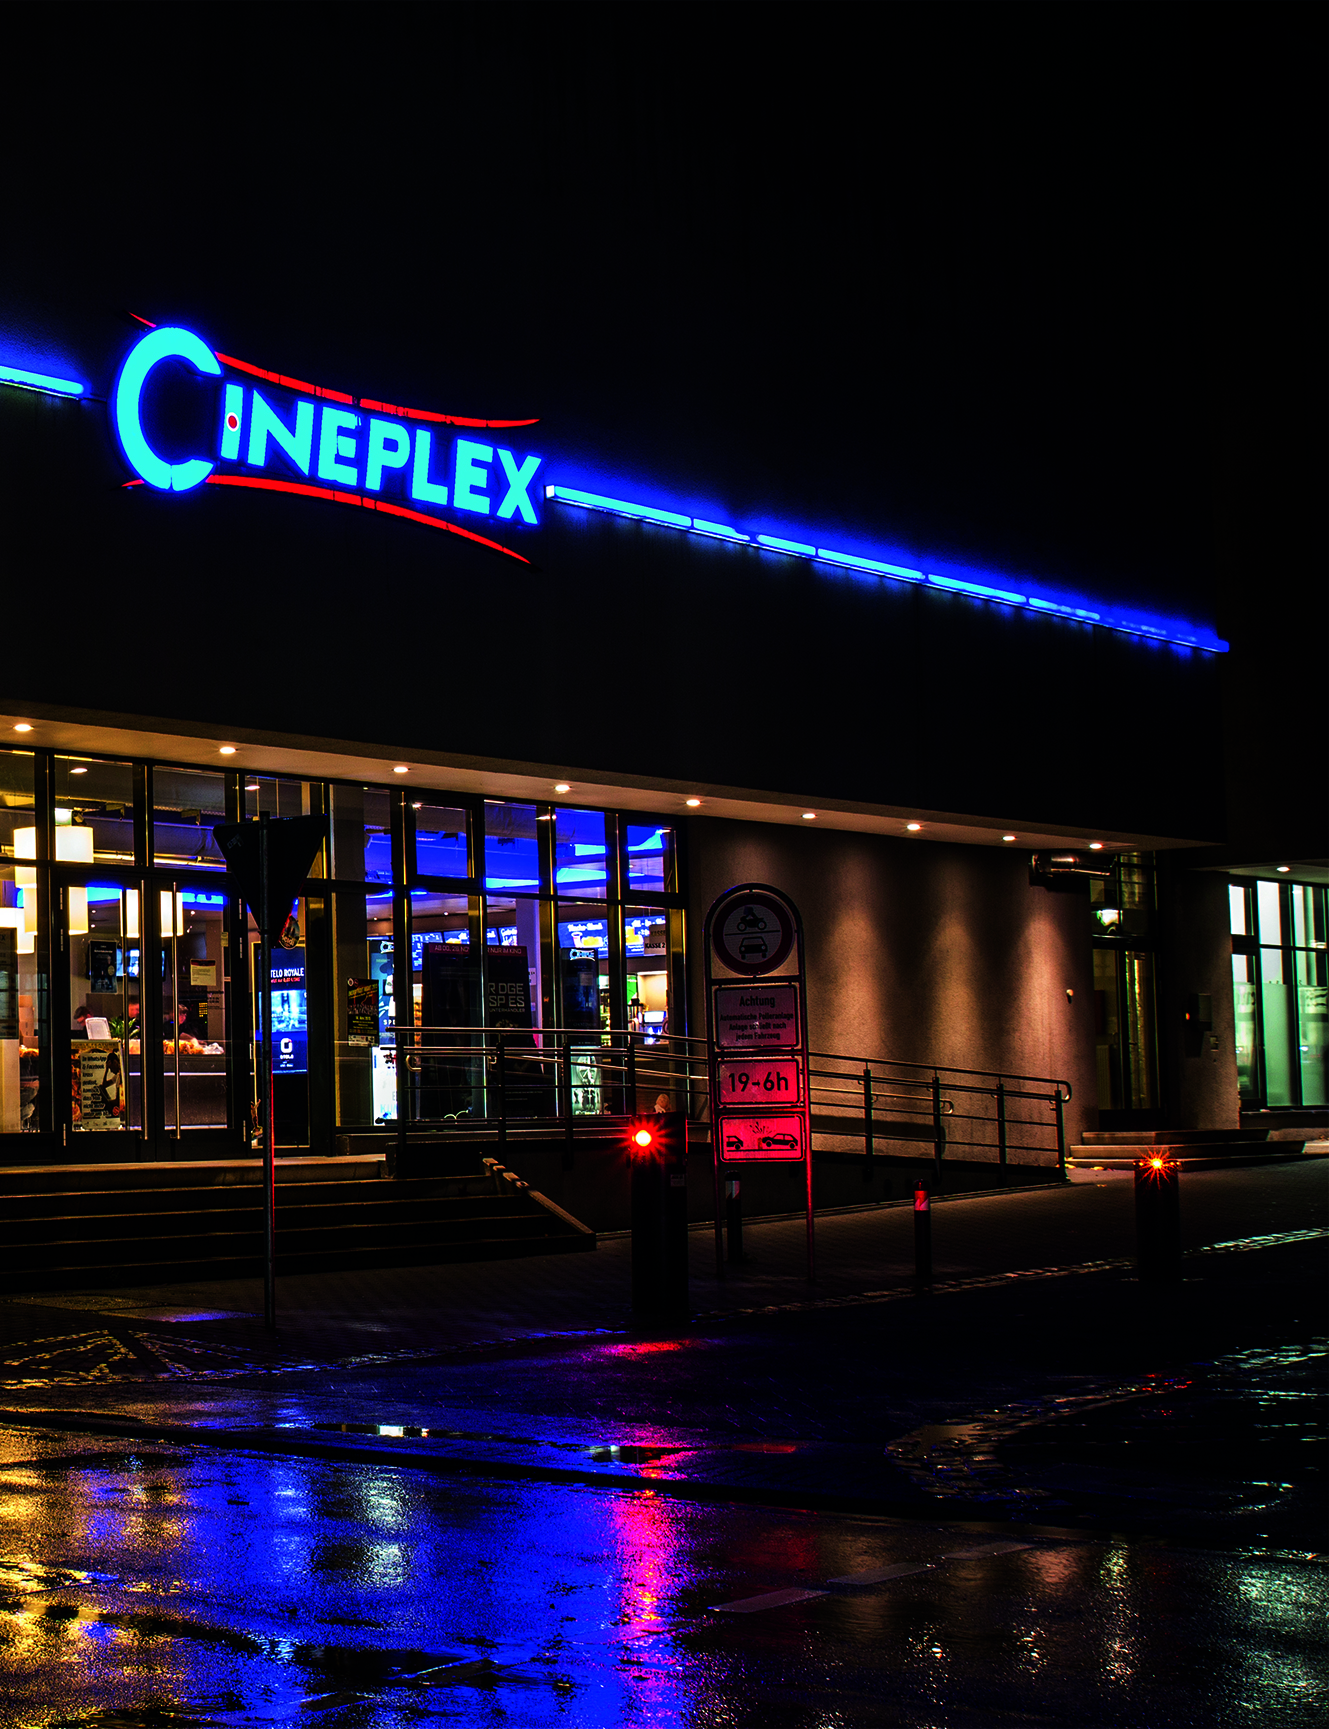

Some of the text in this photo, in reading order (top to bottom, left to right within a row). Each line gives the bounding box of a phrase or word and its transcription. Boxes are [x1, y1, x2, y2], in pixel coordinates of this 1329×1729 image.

[116, 326, 542, 525] CINEPLEX
[739, 996, 775, 1008] Achtung
[720, 1012, 794, 1021] Automatische Polleranlage
[735, 1032, 780, 1041] jedem Fahrzeug
[728, 1071, 788, 1092] 19-6h
